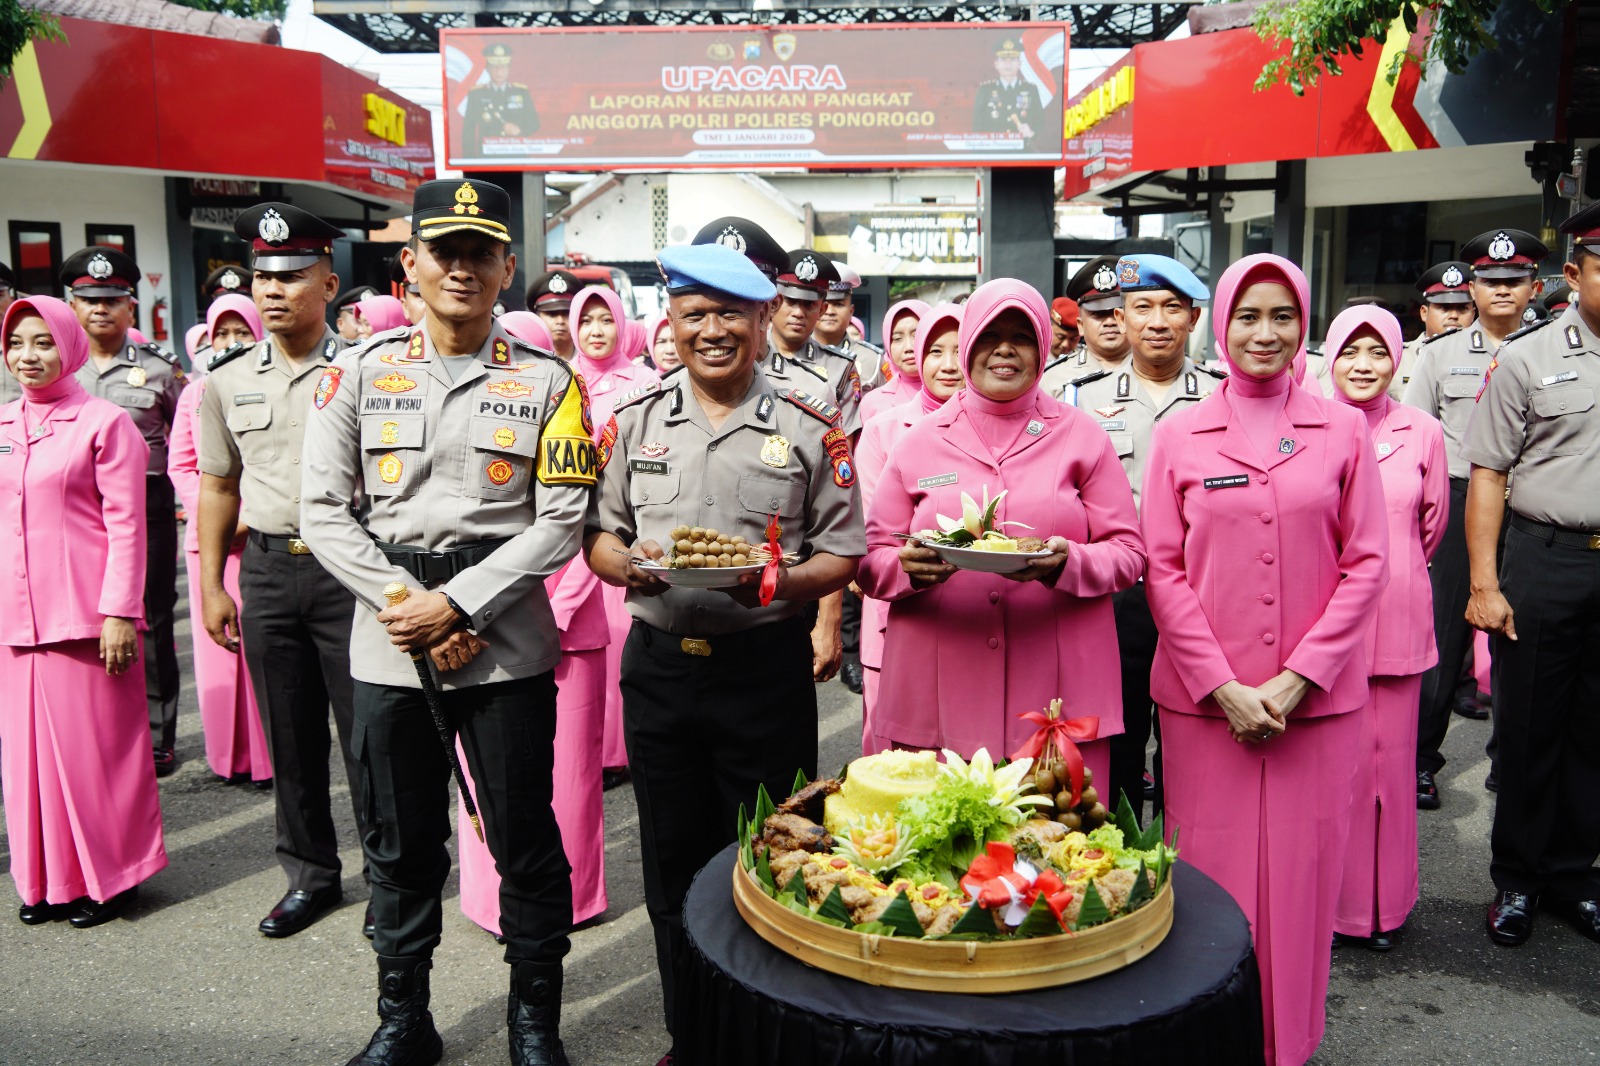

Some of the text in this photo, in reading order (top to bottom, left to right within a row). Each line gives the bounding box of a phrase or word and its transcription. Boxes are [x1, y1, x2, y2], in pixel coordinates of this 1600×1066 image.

[662, 64, 847, 93] UPACARA
[589, 92, 913, 110] LAPORAN KENAIKAN PANGKAT
[566, 110, 935, 130] ANGGOTA POLRI POLRES PONOROGO
[703, 132, 806, 142] TMT 1 JANUARI 2026
[875, 230, 981, 257] BASUKI RA
[364, 397, 422, 411] ANDIN WISNU
[479, 401, 538, 420] POLRI
